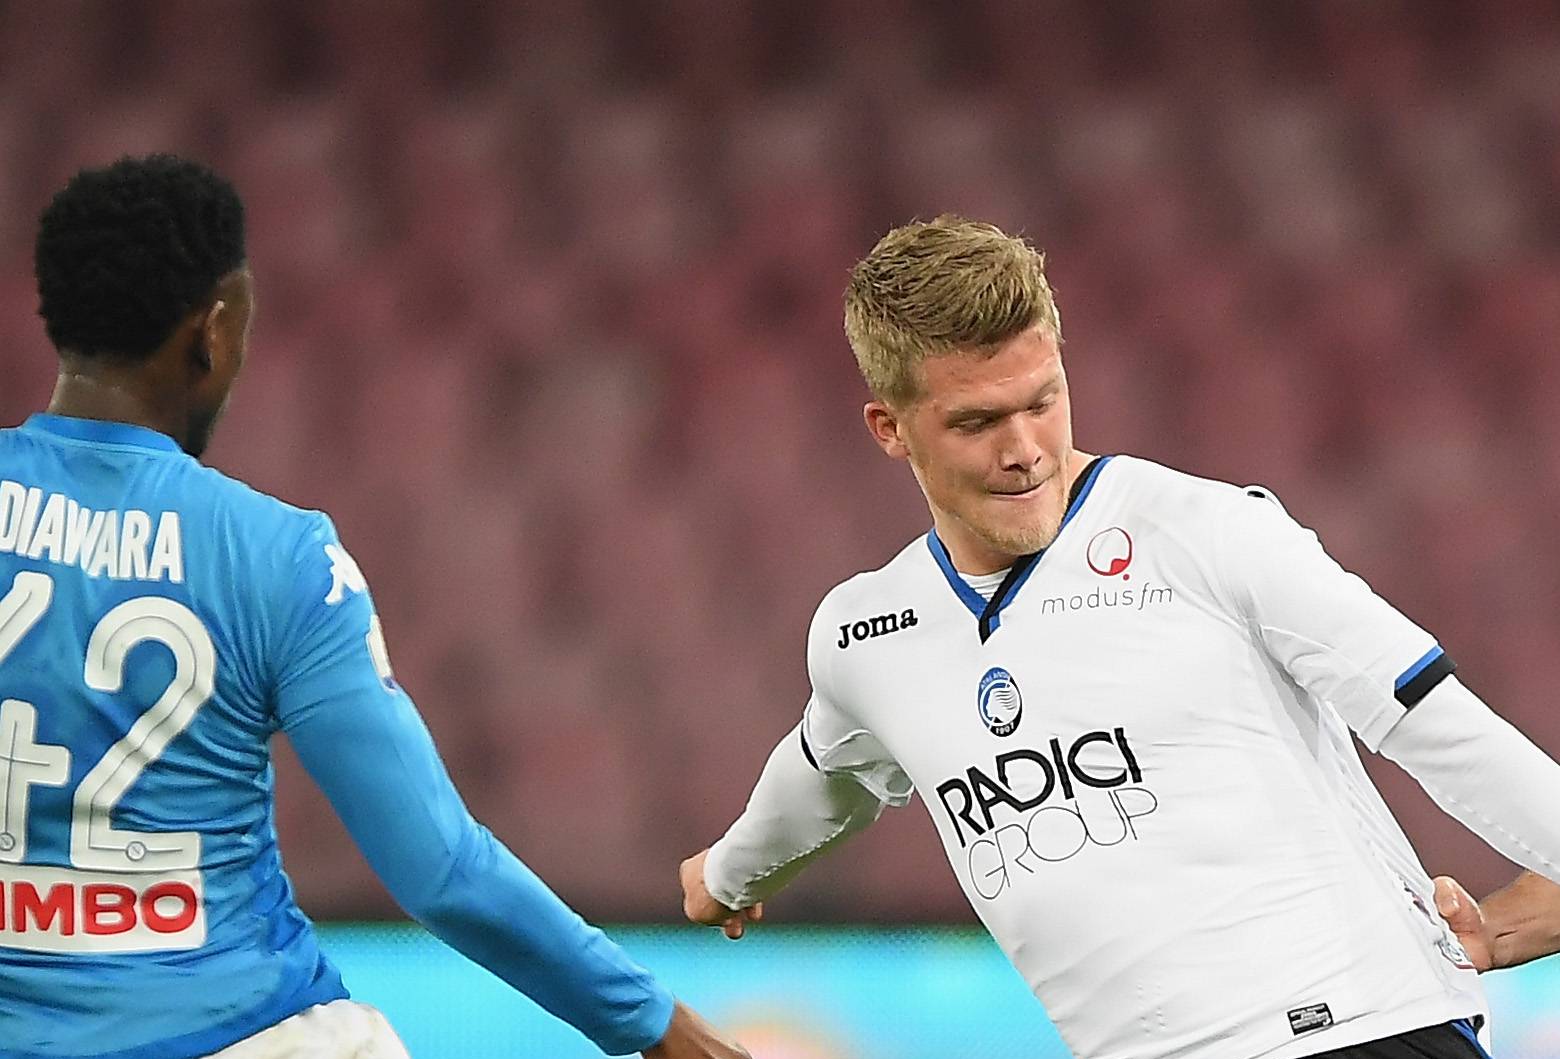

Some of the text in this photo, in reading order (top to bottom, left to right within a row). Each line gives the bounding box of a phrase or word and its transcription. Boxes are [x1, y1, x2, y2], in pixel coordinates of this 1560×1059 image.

[0, 480, 184, 583] DIAWARA
[936, 727, 1142, 848] RADICI
[968, 787, 1158, 900] GROUP
